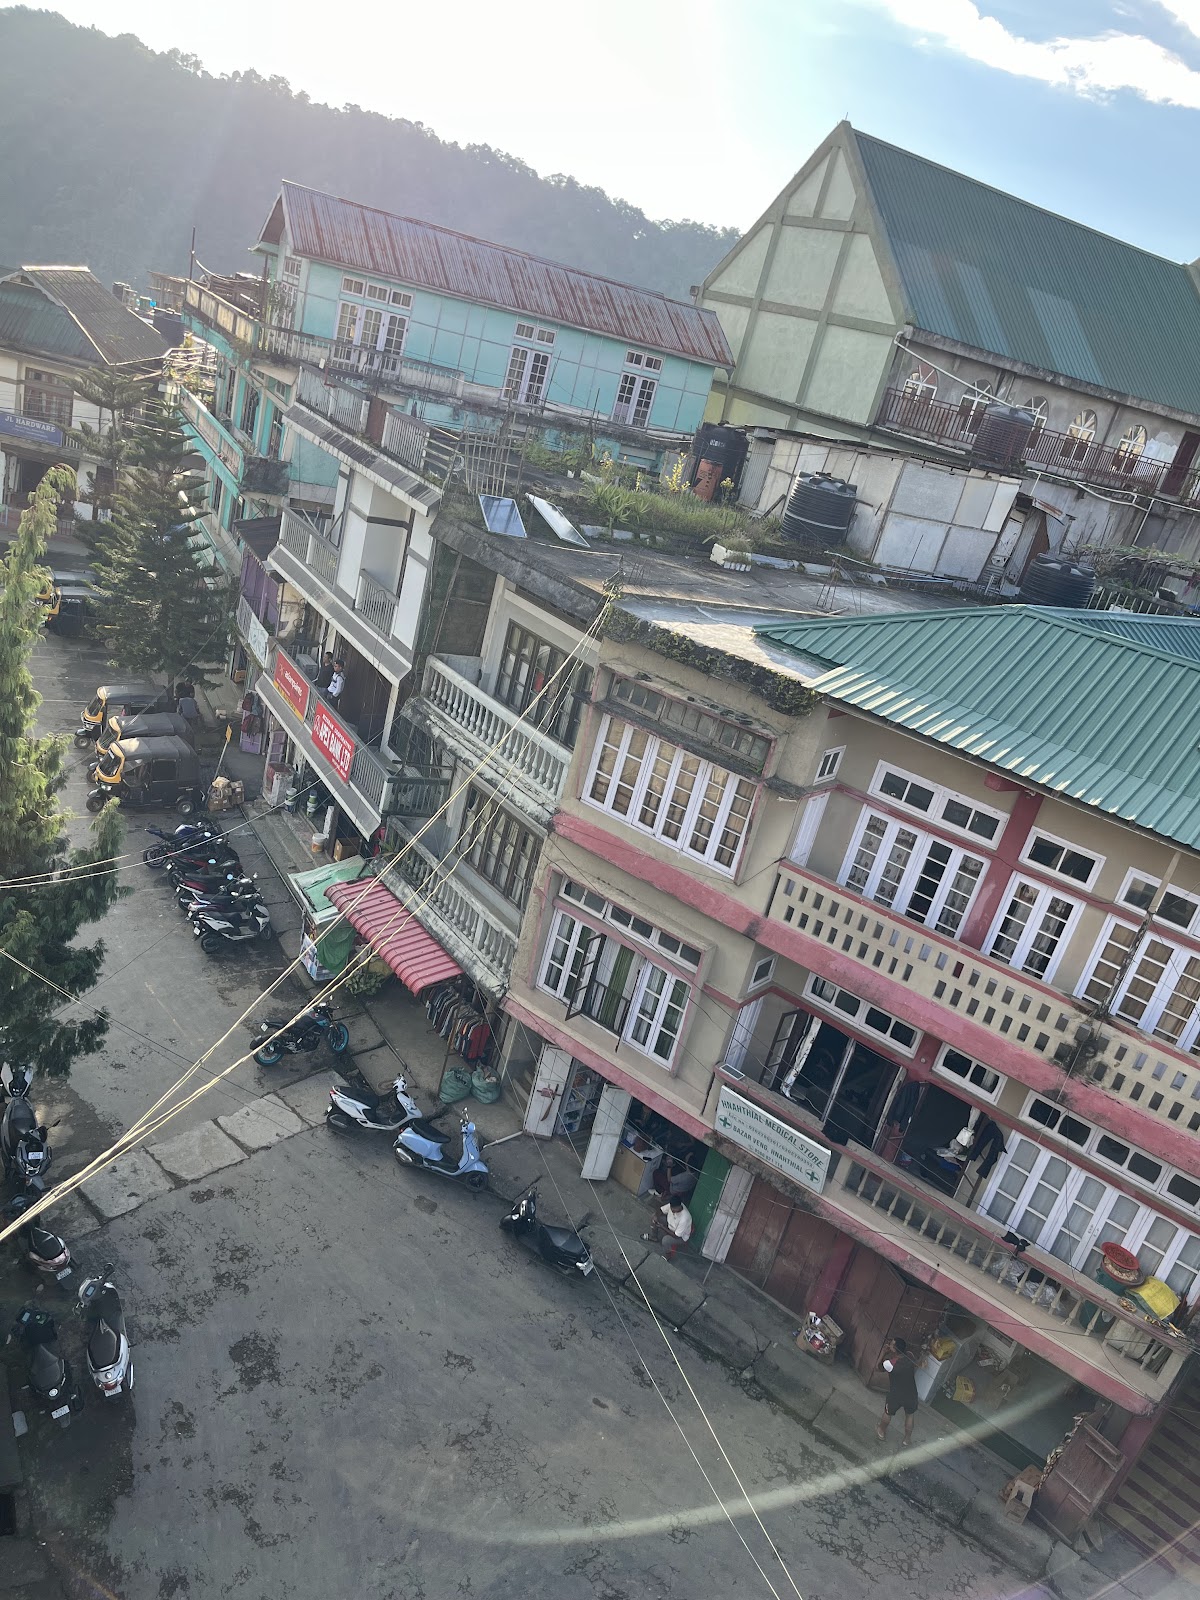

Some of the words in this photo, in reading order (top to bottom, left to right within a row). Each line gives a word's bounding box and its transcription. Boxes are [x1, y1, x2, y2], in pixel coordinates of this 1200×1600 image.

[15, 417, 56, 433] HARDWARE
[319, 721, 331, 748] APEX
[329, 733, 342, 762] BANK
[721, 1100, 763, 1124] HNAHTHIAL
[765, 1119, 797, 1146] MEDICAL
[798, 1144, 824, 1167] STORE
[733, 1125, 752, 1140] BAZAR
[771, 1149, 804, 1173] HNAHTHIAL
